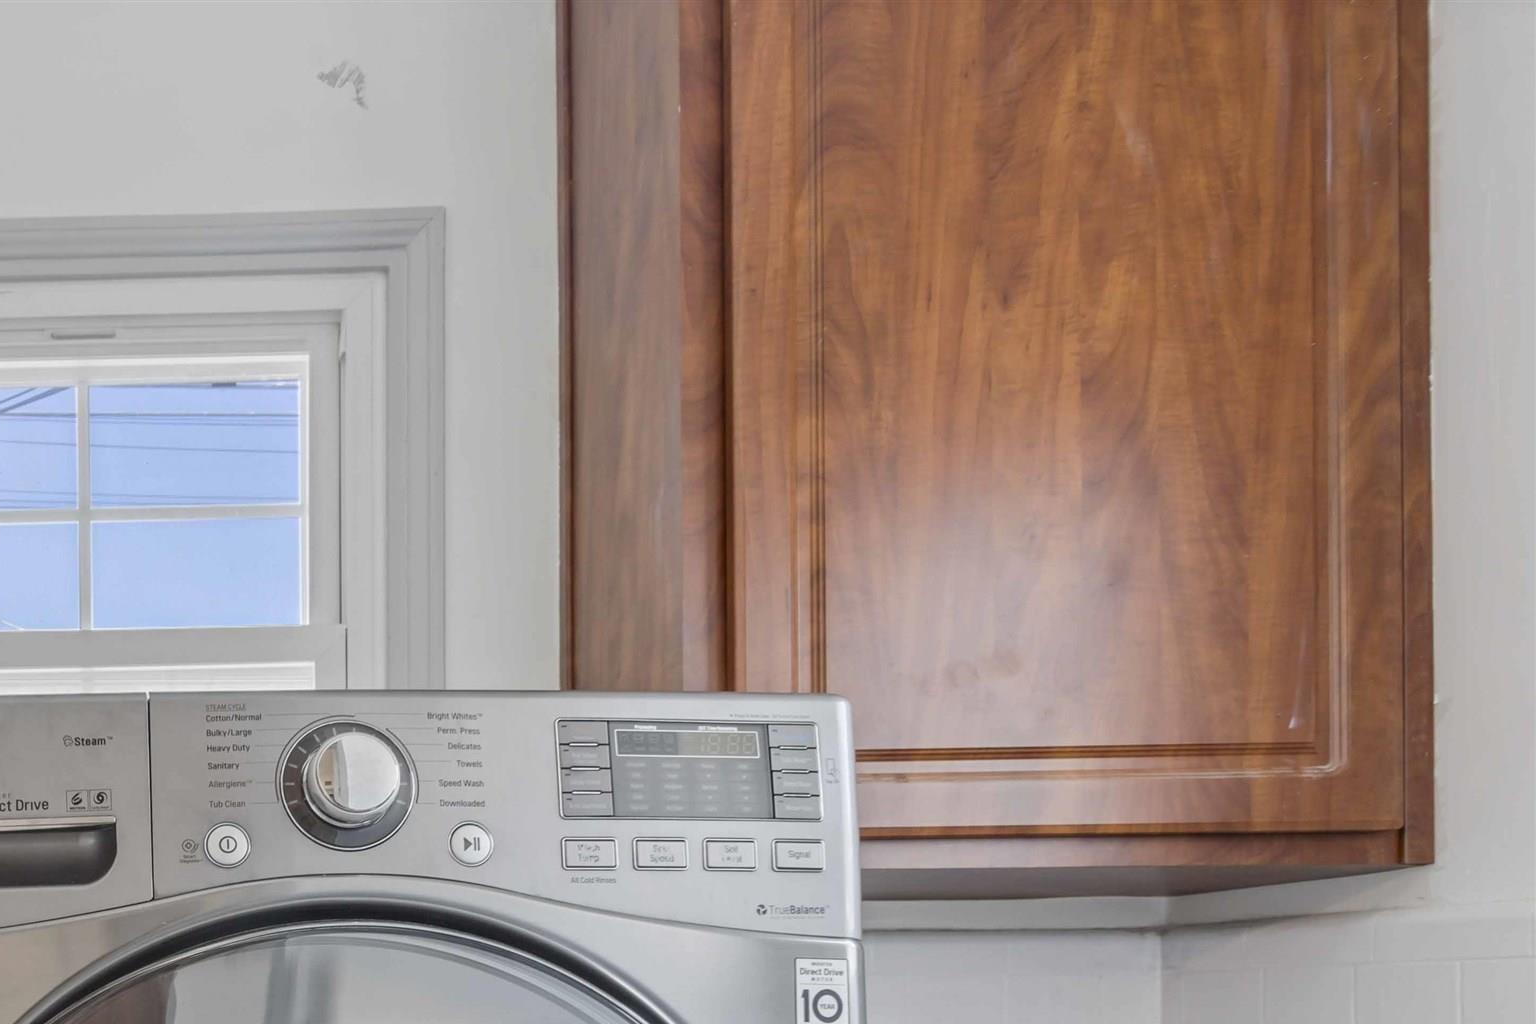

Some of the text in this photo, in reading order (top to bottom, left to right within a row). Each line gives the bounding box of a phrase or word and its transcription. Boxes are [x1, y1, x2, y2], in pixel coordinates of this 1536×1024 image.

[205, 712, 263, 723] Cotton/Normal
[427, 711, 450, 721] Bright
[206, 728, 253, 738] Bulky/Large
[460, 727, 481, 735] Press
[206, 744, 250, 754] Heavy Duty
[447, 742, 483, 751] Delicates
[207, 761, 240, 771] Sanitary
[456, 759, 483, 769] Towels
[438, 779, 485, 788] Speed Wash
[15, 799, 49, 811] Drive
[209, 800, 246, 809] Tub Clean
[440, 799, 486, 808] Downloaded
[799, 967, 844, 977] Direct Drive
[801, 988, 844, 1024] 10
